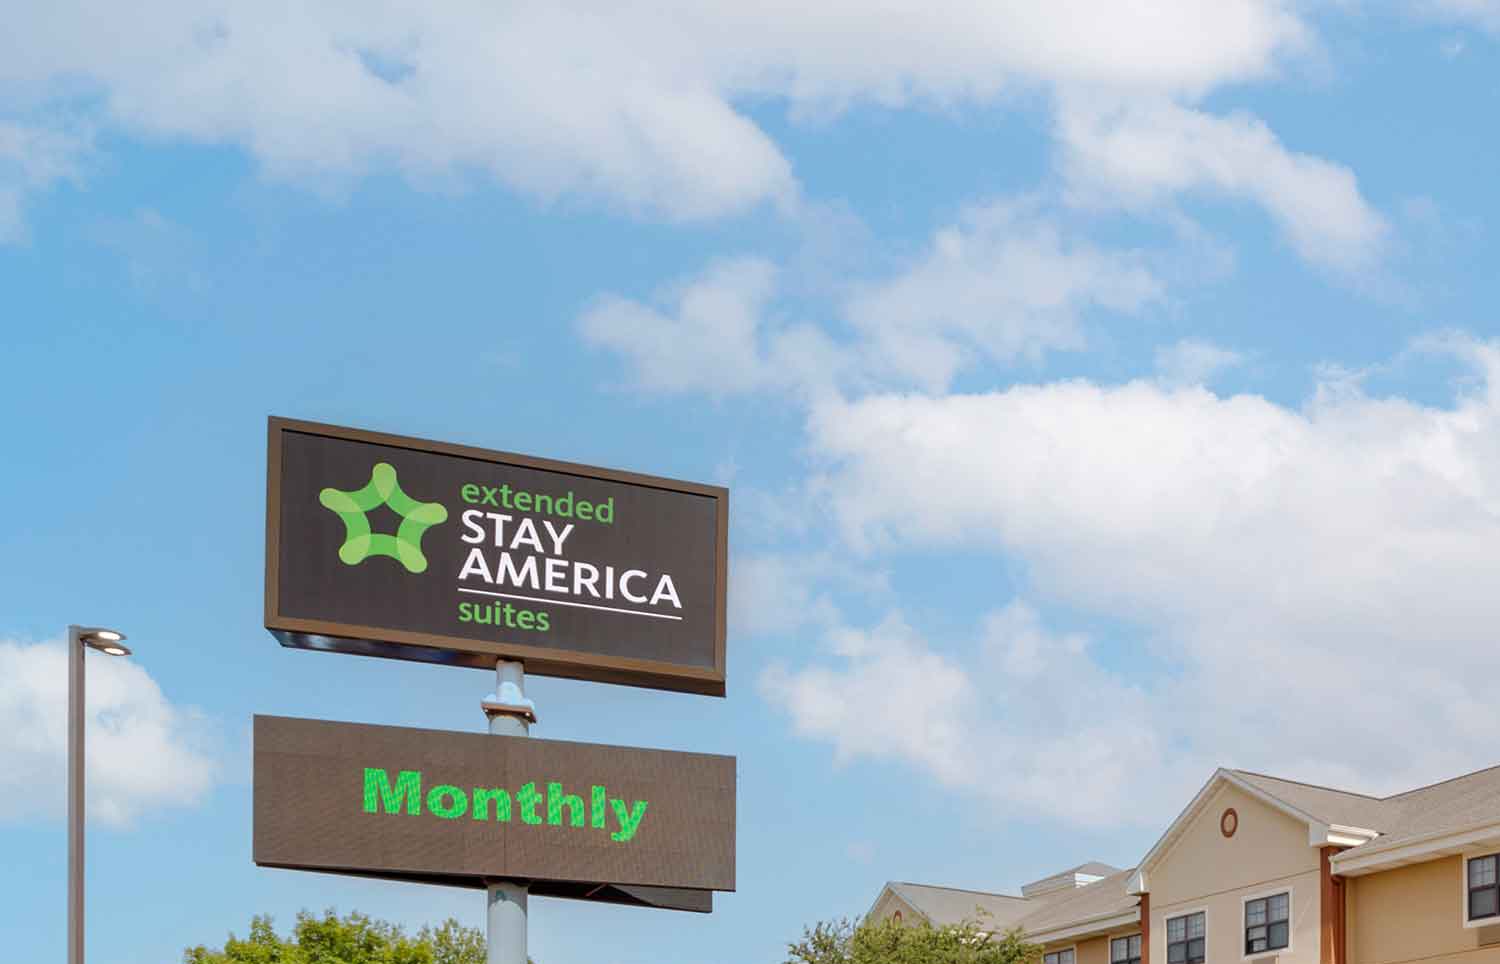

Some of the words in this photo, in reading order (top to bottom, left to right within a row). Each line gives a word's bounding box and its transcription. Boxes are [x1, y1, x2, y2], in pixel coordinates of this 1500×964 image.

[461, 483, 614, 523] extended
[461, 509, 574, 555] STAY
[458, 547, 682, 609] AMERICA
[458, 600, 550, 631] suites
[363, 767, 648, 842] Monthly
